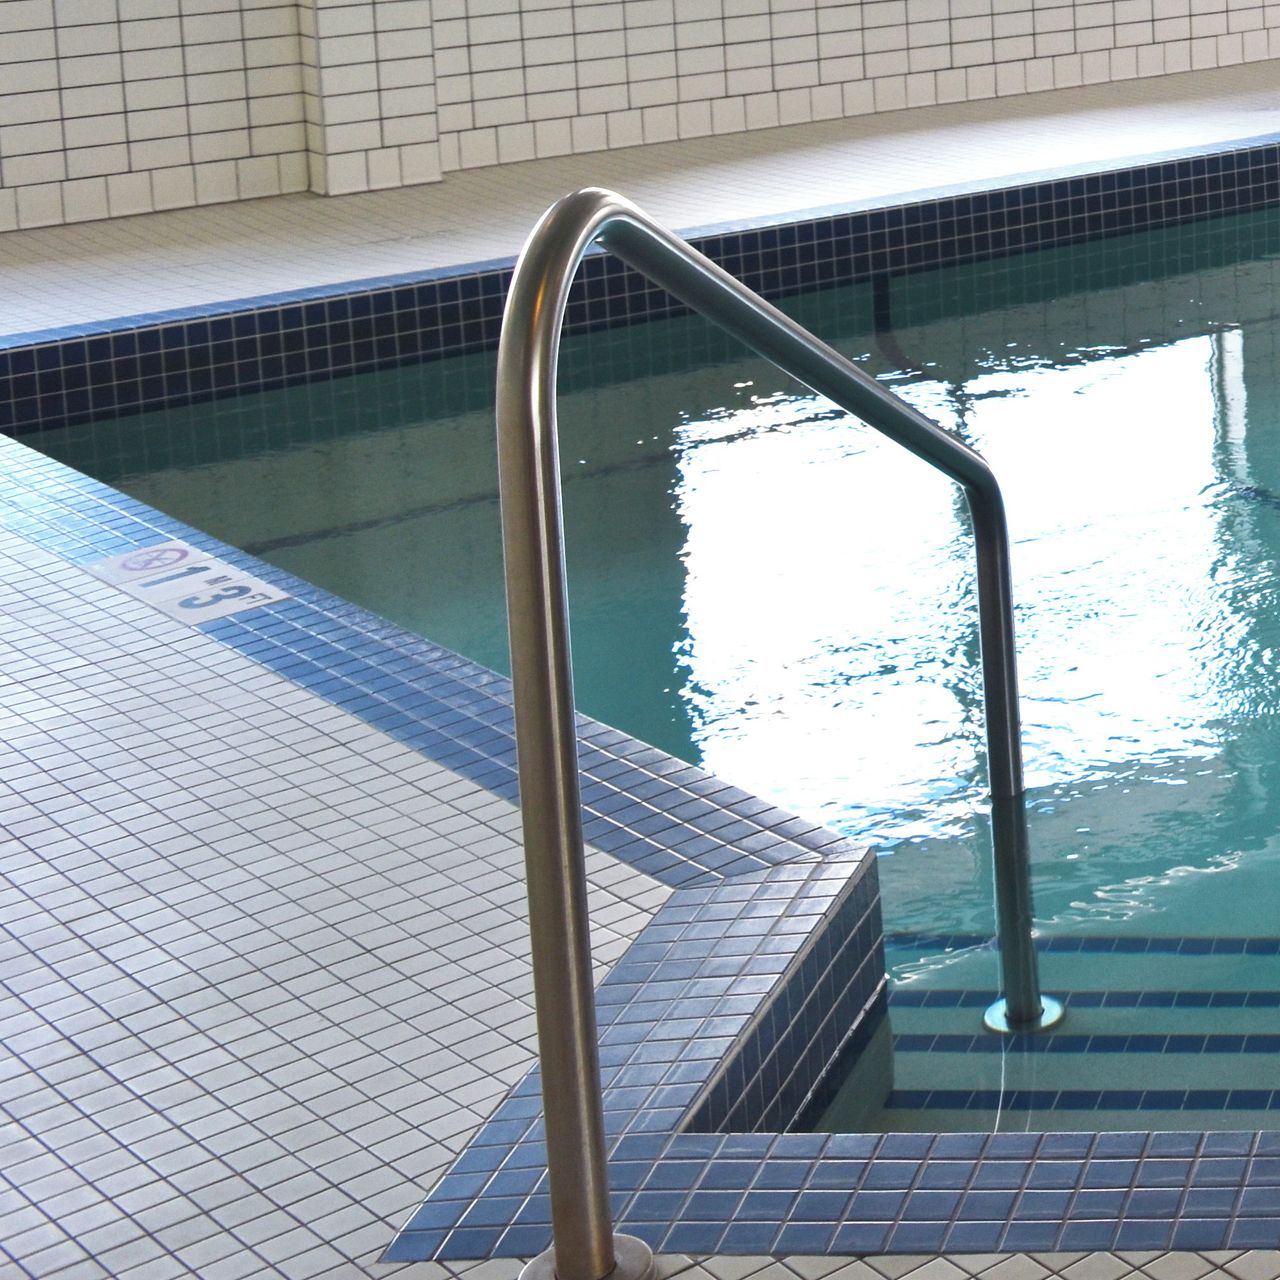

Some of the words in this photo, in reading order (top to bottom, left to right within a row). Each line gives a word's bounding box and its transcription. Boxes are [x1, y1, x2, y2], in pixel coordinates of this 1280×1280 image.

[138, 565, 212, 589] 1
[178, 585, 252, 609] 3
[237, 592, 273, 605] FT
